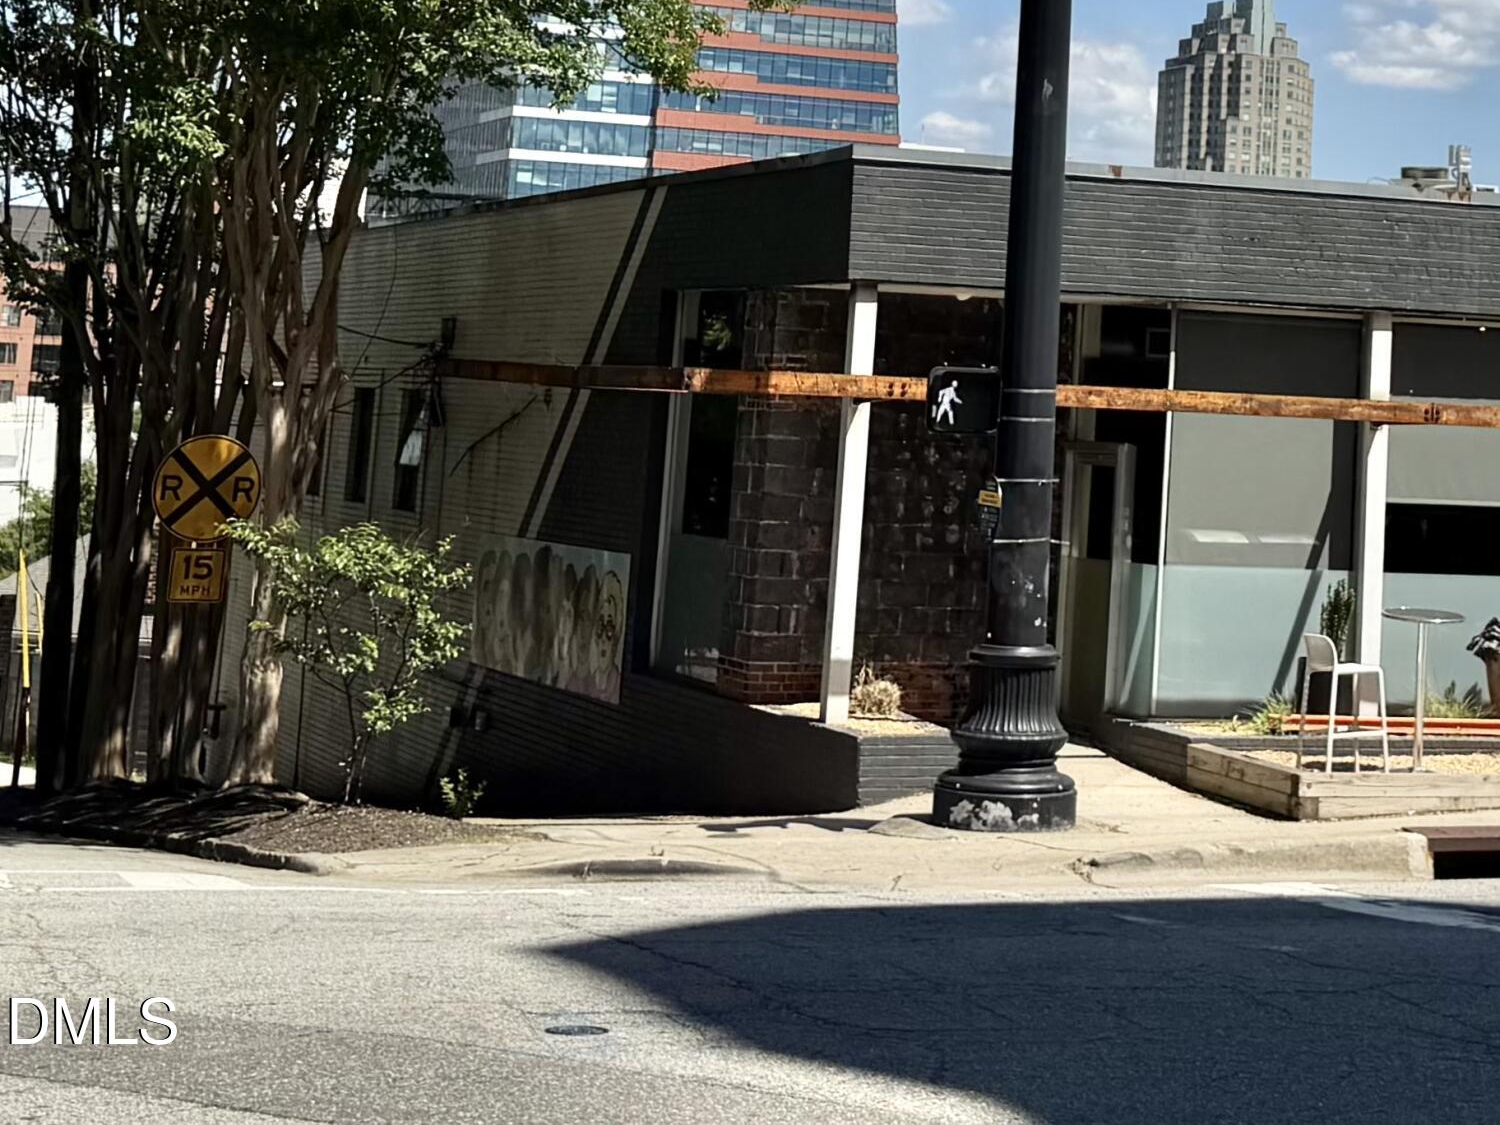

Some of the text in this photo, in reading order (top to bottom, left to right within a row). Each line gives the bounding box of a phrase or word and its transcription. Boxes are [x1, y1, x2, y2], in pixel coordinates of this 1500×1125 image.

[160, 475, 256, 503] R R
[183, 554, 214, 580] 15
[179, 584, 211, 597] MPH
